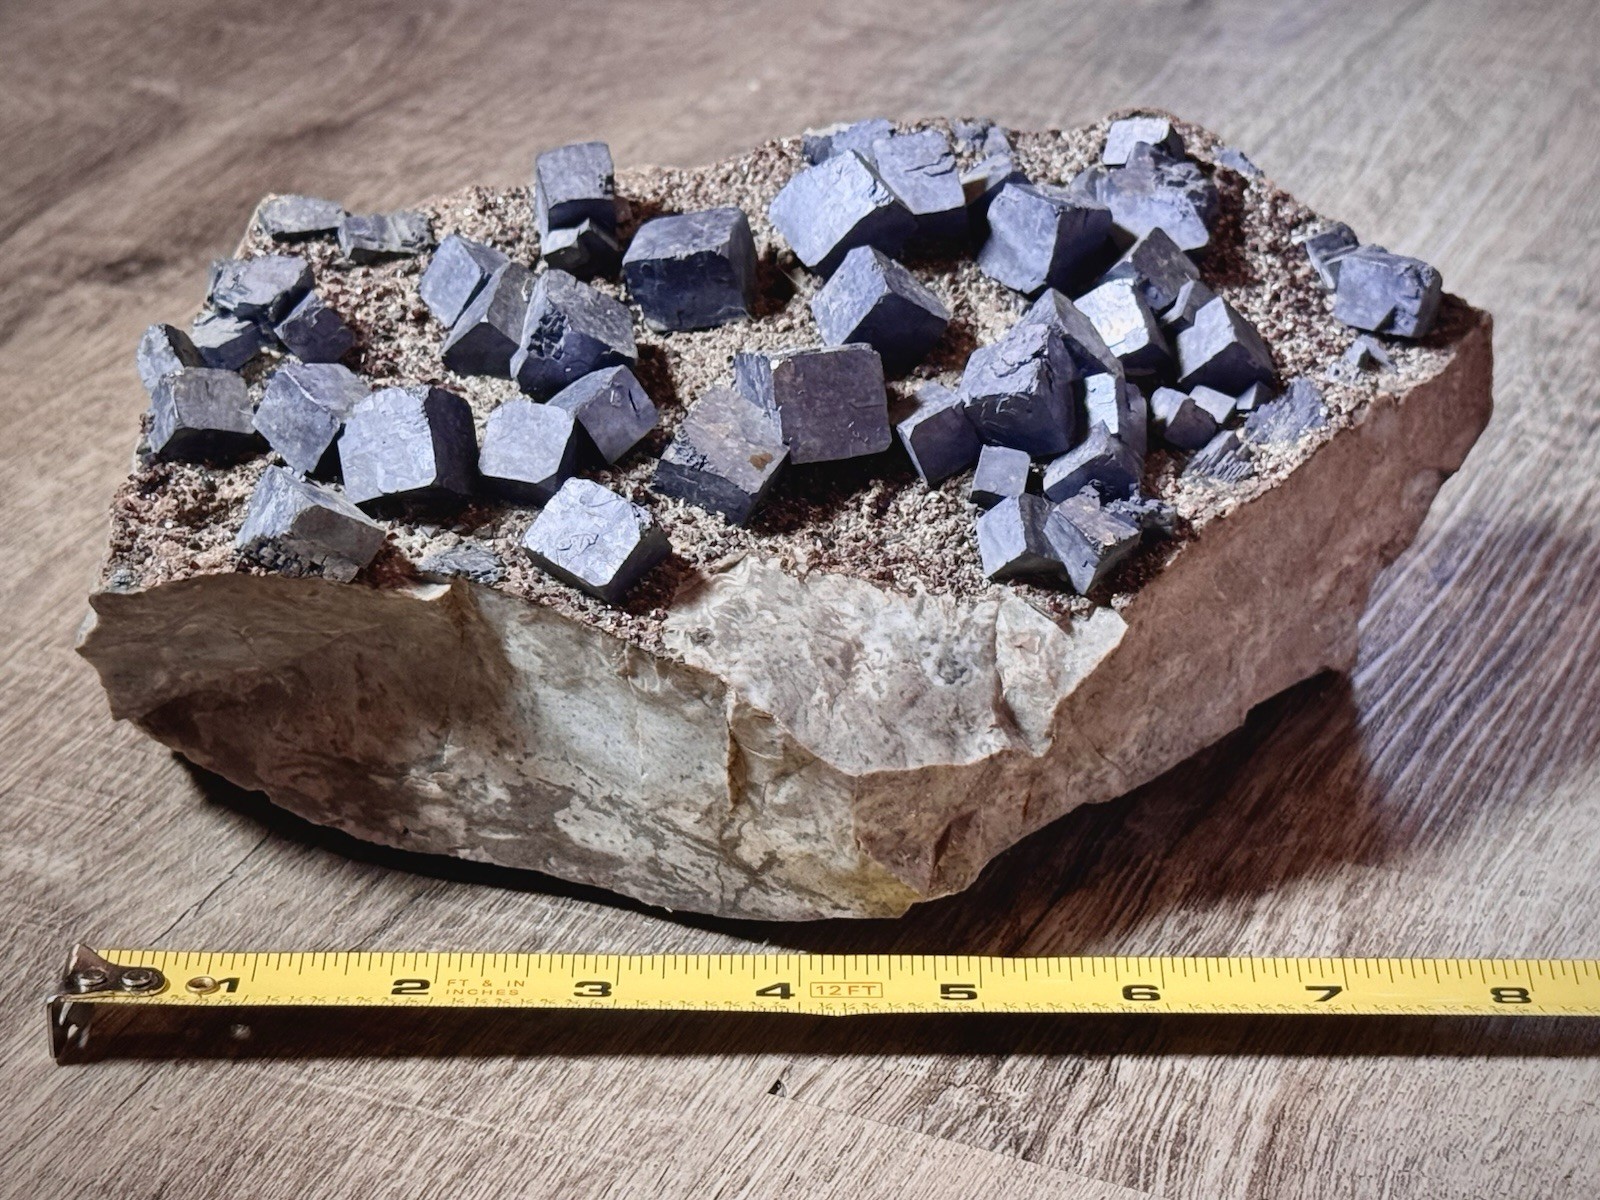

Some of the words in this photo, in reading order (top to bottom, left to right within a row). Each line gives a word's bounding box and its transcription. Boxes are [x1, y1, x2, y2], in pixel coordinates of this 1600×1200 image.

[217, 977, 240, 993] 1
[391, 979, 430, 995] 2
[446, 979, 468, 987] FT
[482, 979, 493, 987] &
[573, 981, 612, 997] 3
[755, 982, 796, 1000] 4
[939, 983, 978, 1000] 5
[1122, 984, 1161, 1001] 6
[1305, 985, 1343, 1002] 7
[1490, 987, 1532, 1003] 8
